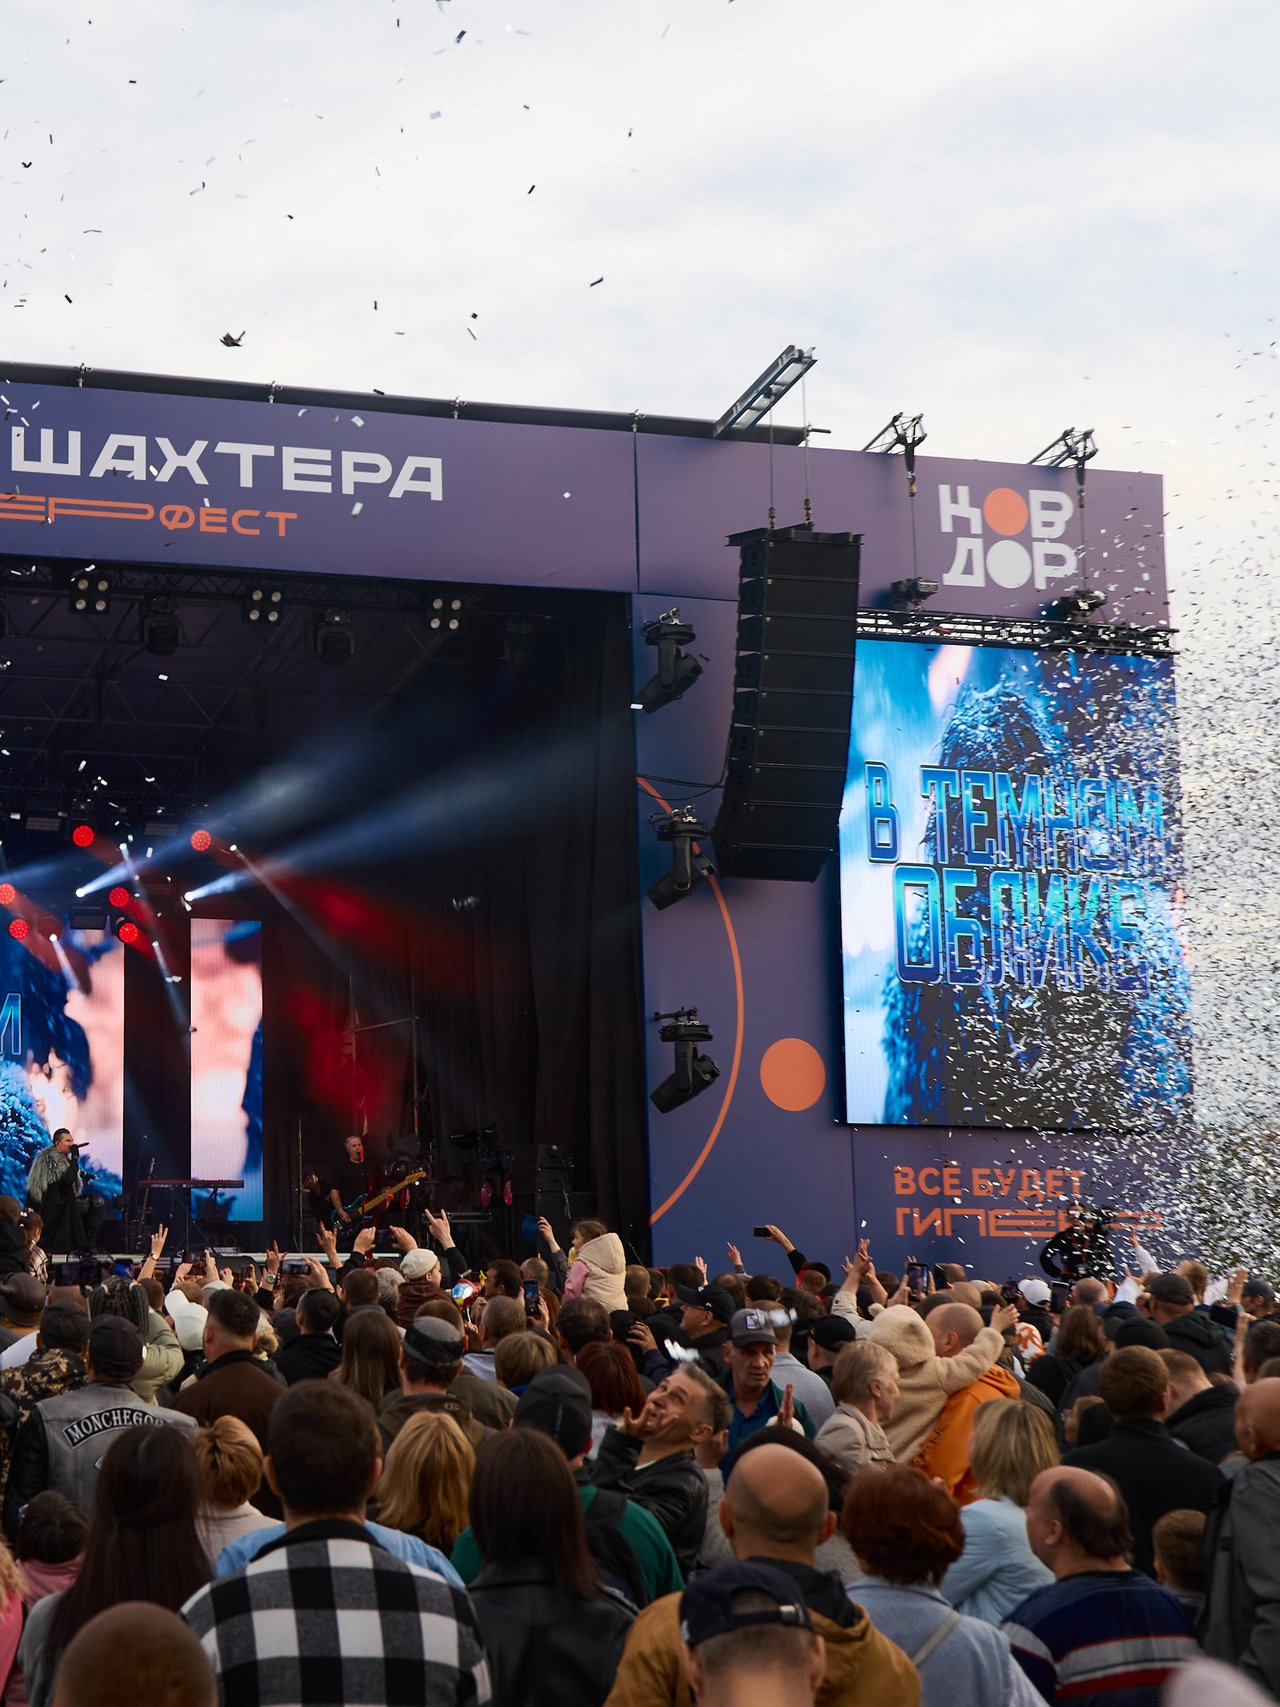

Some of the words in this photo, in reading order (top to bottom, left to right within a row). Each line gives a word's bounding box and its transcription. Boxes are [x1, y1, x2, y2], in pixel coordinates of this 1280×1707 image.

[11, 425, 444, 501] ШАХТЕРА
[864, 761, 900, 864] В
[920, 765, 1170, 876] ТЕМНОМ
[893, 864, 1152, 993] ОБЛИКЕ
[972, 1168, 1084, 1202] БУДЕТ
